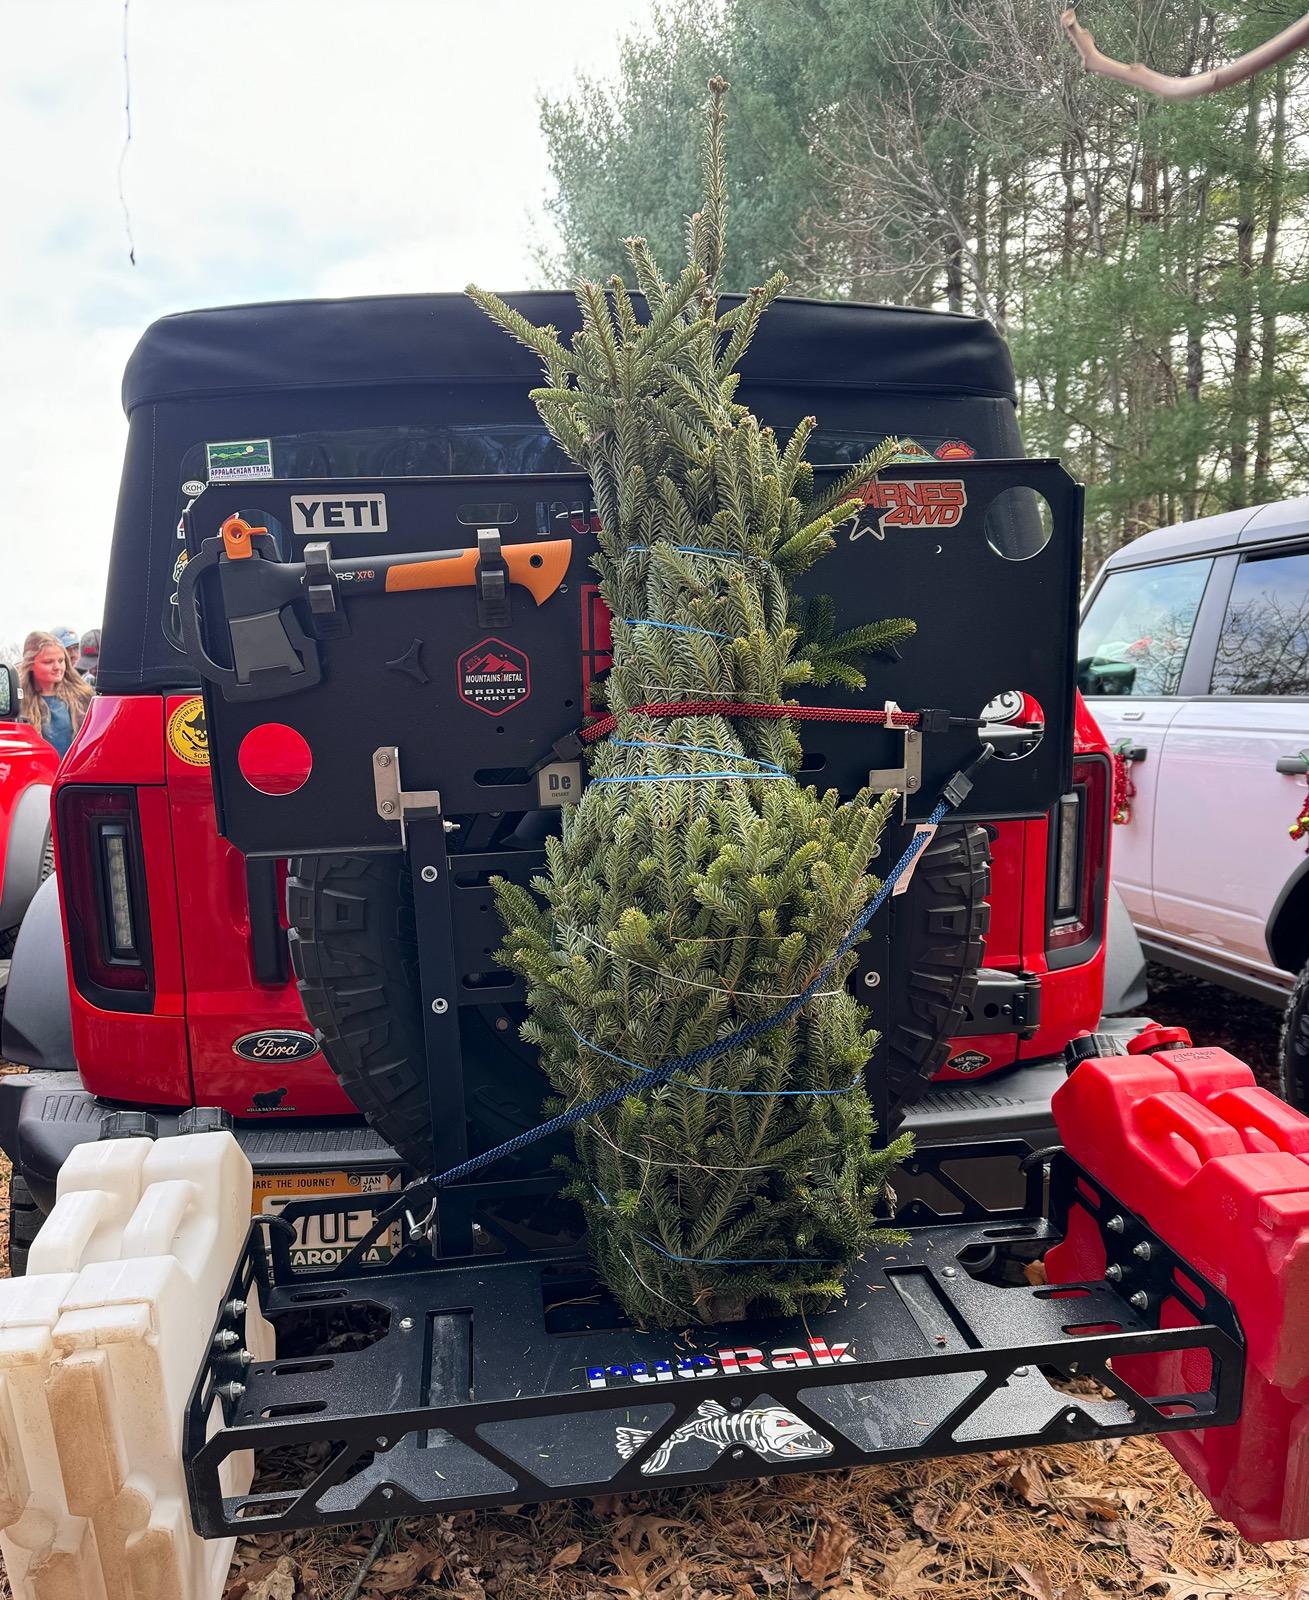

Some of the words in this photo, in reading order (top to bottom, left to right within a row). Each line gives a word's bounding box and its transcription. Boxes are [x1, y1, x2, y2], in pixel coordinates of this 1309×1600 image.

[210, 466, 252, 476] APPALACHIAN
[252, 465, 271, 474] TRAIL
[185, 484, 203, 492] KOH
[295, 500, 380, 528] YETI
[885, 504, 960, 525] 4WD
[464, 687, 526, 695] BRONCO
[549, 774, 571, 790] De
[253, 1038, 299, 1057] Ford
[253, 1179, 272, 1189] ARE
[276, 1179, 293, 1189] THE
[297, 1177, 336, 1188] JOURNEY
[363, 1176, 381, 1185] JAN
[362, 1184, 372, 1193] 24
